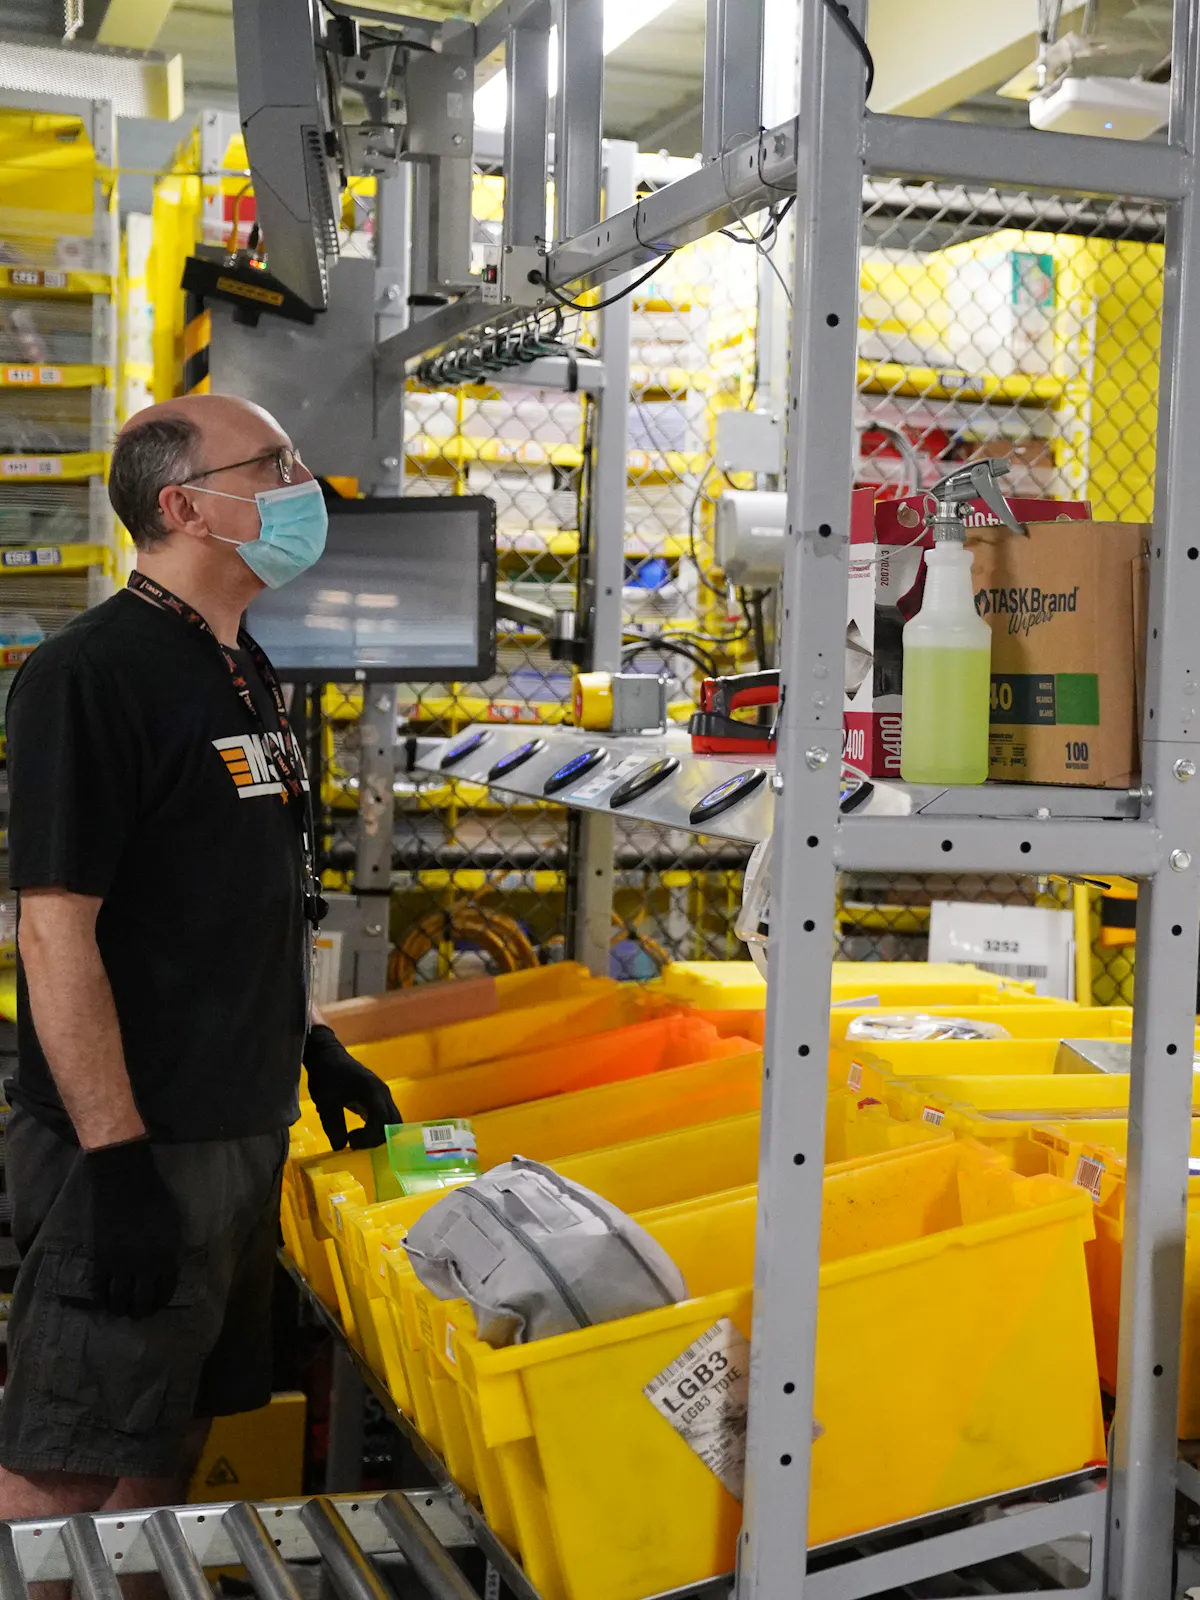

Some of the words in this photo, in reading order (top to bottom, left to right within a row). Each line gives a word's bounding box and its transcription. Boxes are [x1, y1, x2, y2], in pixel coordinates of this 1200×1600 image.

[1065, 742, 1089, 762] 100
[662, 1351, 728, 1414] LGB3
[681, 1395, 711, 1424] LGB3
[712, 1366, 741, 1394] TOTE
